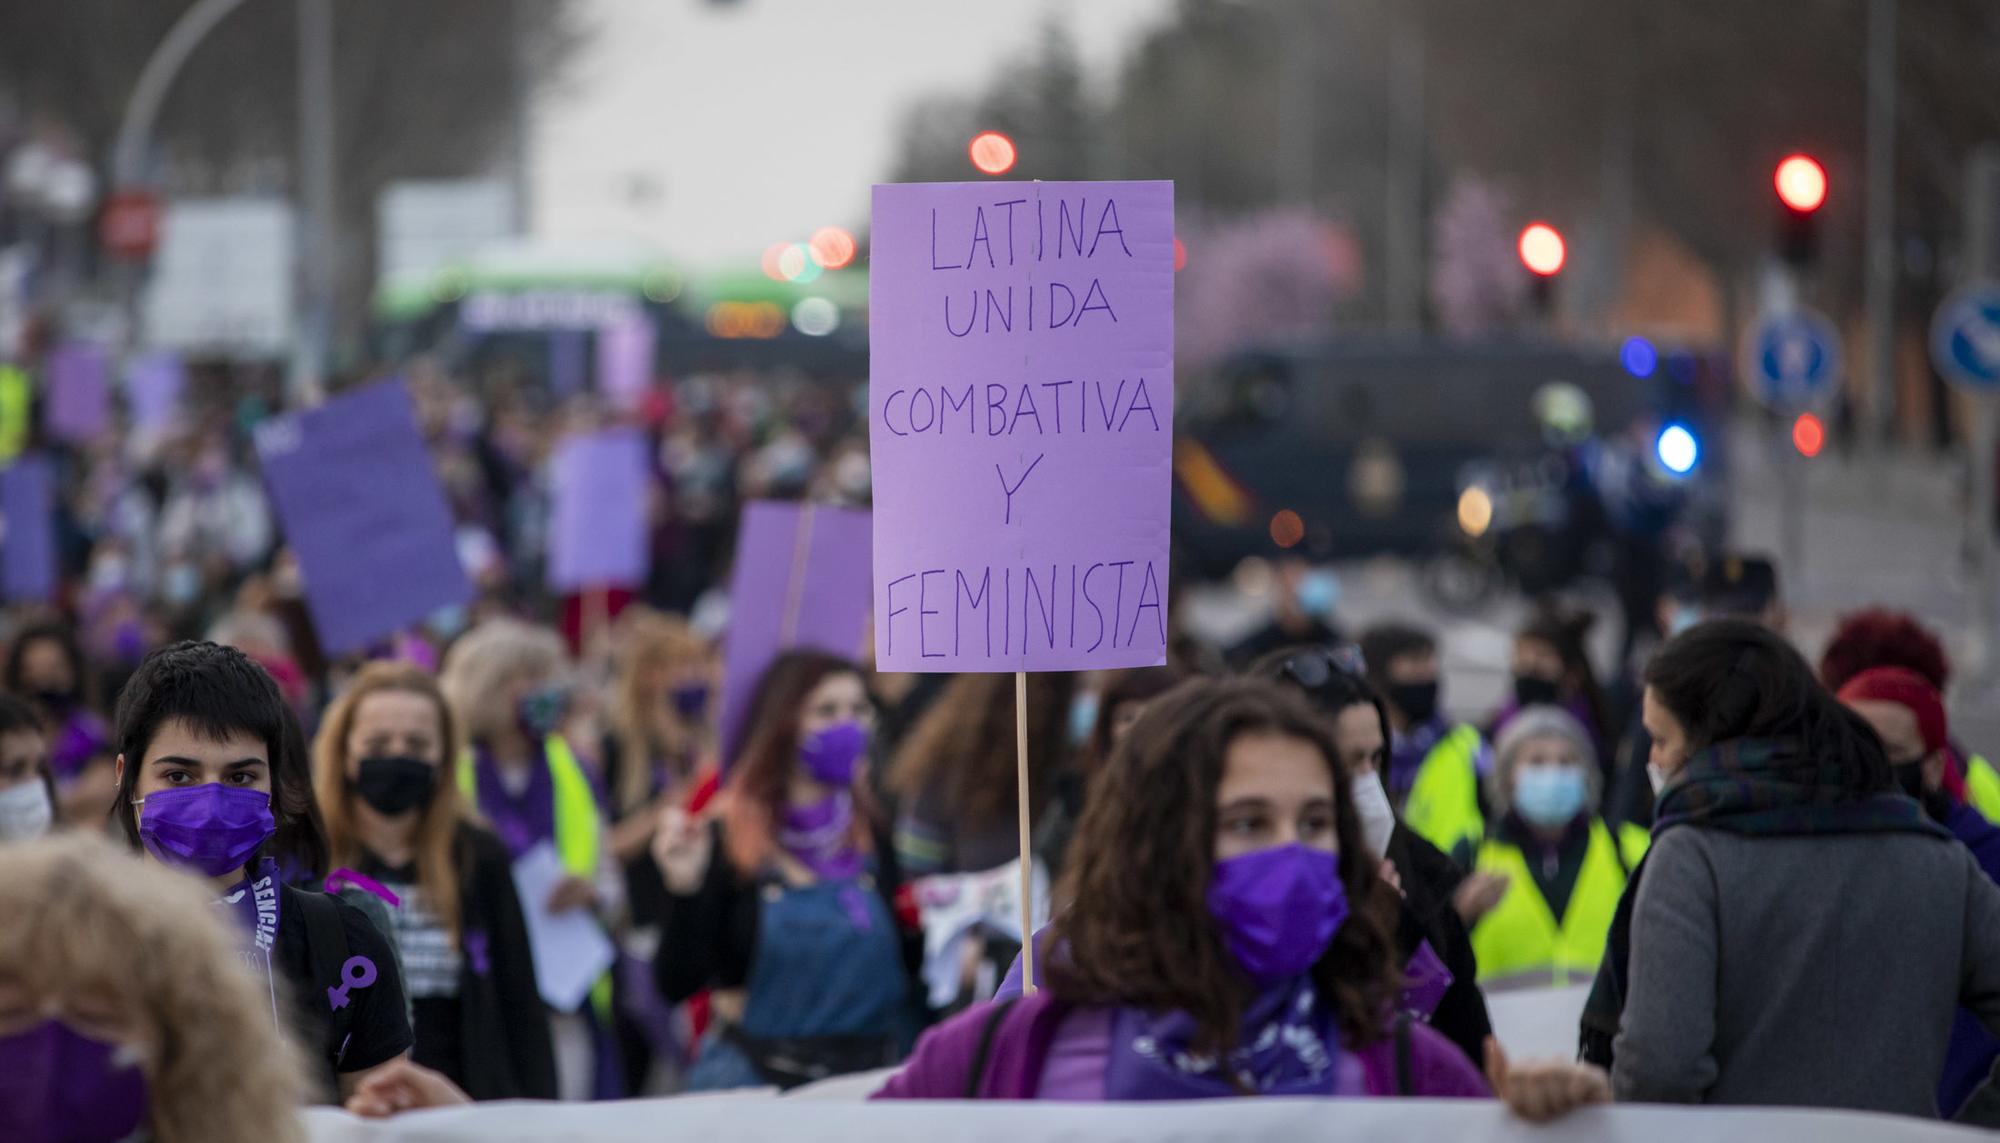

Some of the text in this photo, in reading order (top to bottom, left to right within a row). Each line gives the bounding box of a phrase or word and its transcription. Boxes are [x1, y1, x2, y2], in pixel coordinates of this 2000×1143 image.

[932, 198, 1132, 270] LATINA
[945, 278, 1117, 337] UNIDA
[883, 377, 1160, 436] COMBATIVA
[996, 453, 1044, 525] Y
[887, 560, 1166, 658] FEMINISTA
